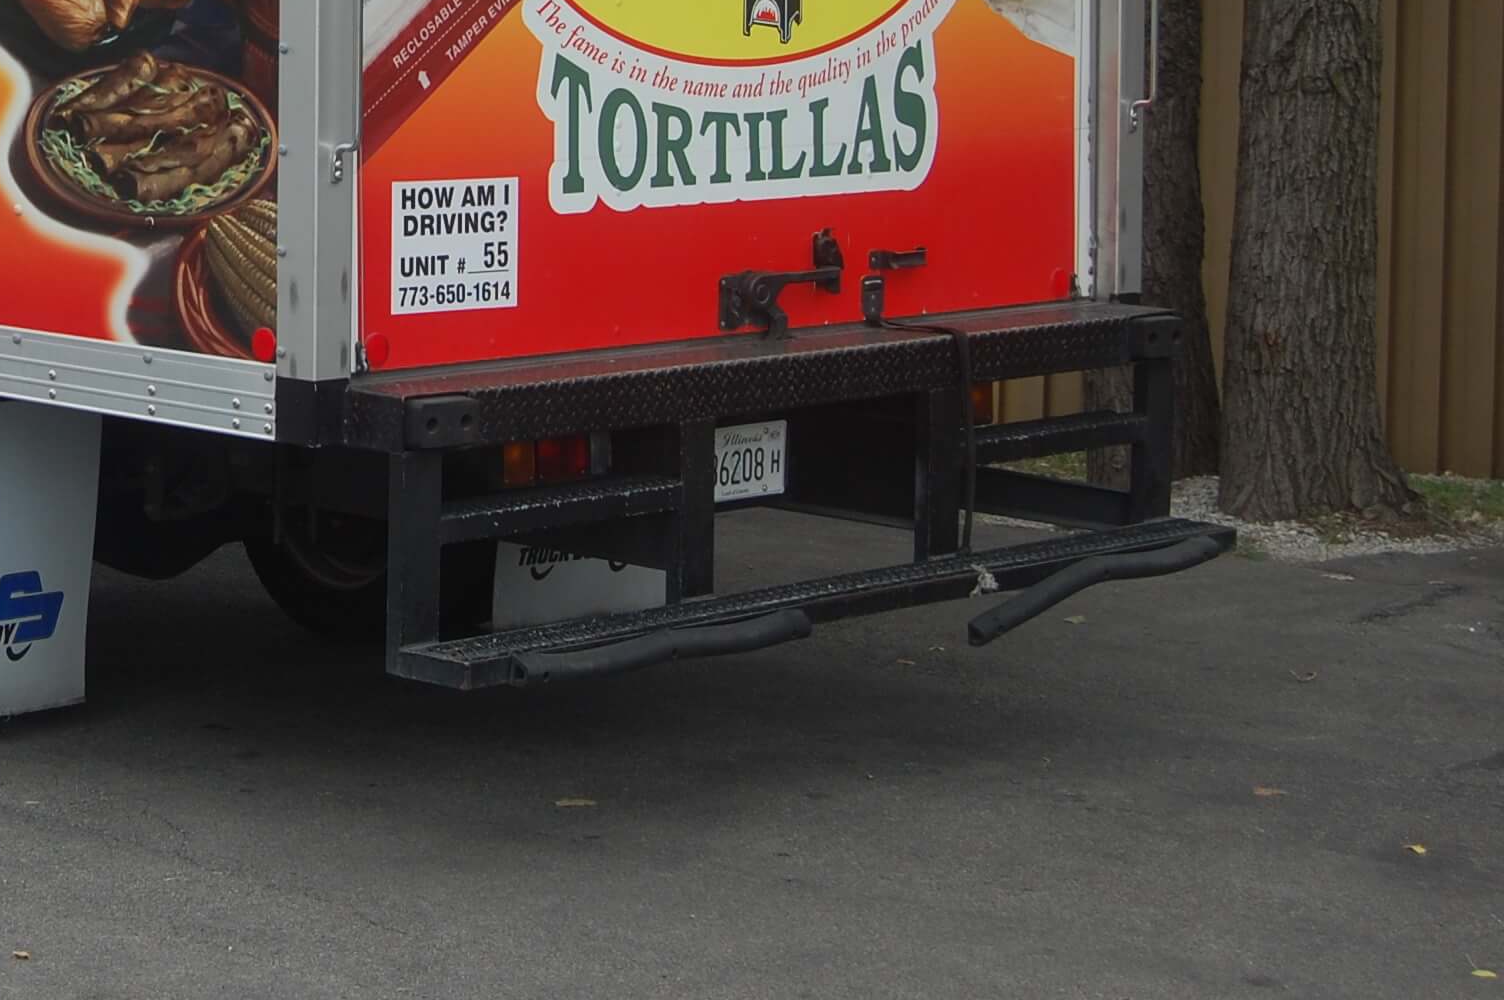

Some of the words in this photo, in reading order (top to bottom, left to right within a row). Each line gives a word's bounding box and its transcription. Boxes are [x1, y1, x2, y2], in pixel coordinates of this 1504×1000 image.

[445, 15, 489, 62] TAMPER
[560, 25, 609, 66] fame
[612, 50, 626, 74] is
[630, 58, 648, 82] in
[652, 66, 679, 92] the
[682, 79, 727, 99] name
[732, 73, 763, 99] and
[769, 71, 793, 96] the
[798, 58, 852, 98] quality
[856, 46, 872, 72] in
[876, 30, 899, 57] the
[551, 40, 927, 194] TORTILLAS
[401, 186, 455, 210] HOW
[461, 184, 495, 208] AM
[504, 184, 510, 205] I
[403, 210, 508, 237] DRIVING?
[400, 255, 449, 277] UNIT
[457, 257, 466, 274] #
[483, 241, 509, 268] 55
[399, 281, 511, 307] 773-650-1614
[713, 447, 765, 487] 6208
[770, 449, 781, 474] H
